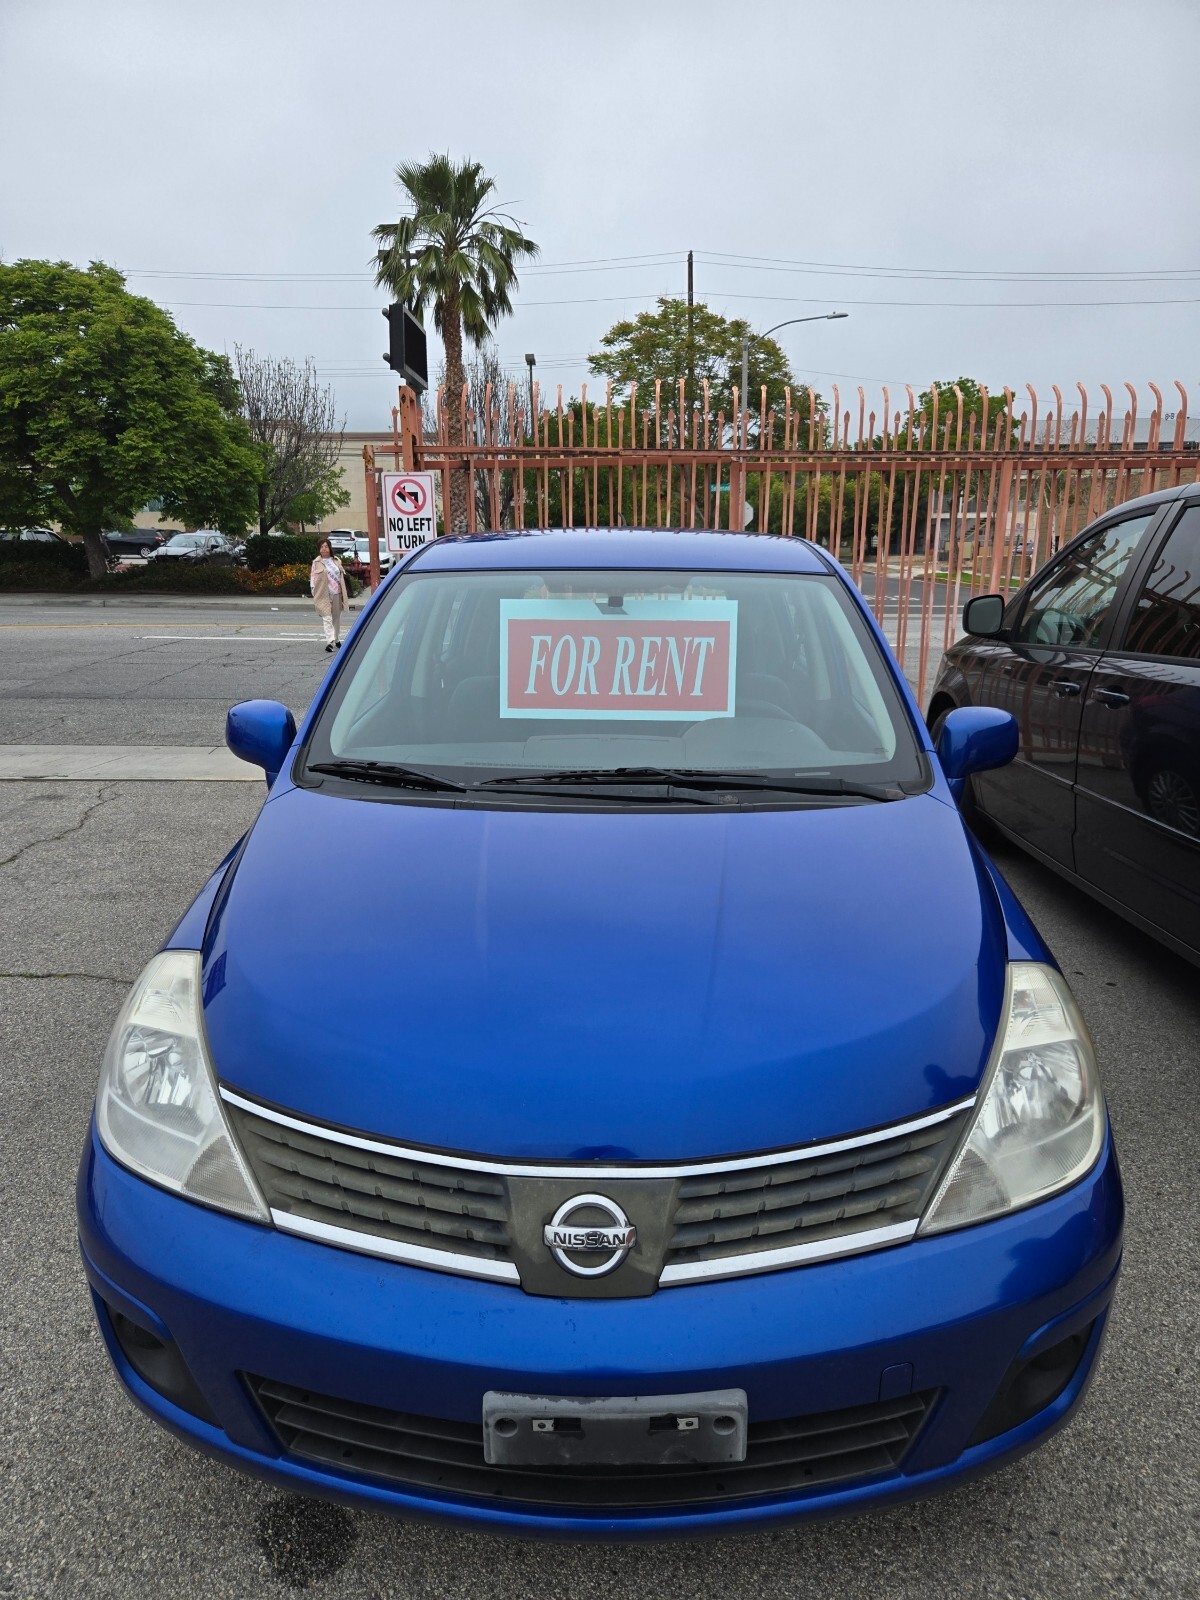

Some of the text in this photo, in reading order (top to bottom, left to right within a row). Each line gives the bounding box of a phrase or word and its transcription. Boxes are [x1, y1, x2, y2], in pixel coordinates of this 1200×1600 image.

[389, 517, 432, 532] NO LEFT
[524, 634, 716, 697] FOR RENT
[553, 1231, 626, 1247] NISSAN
